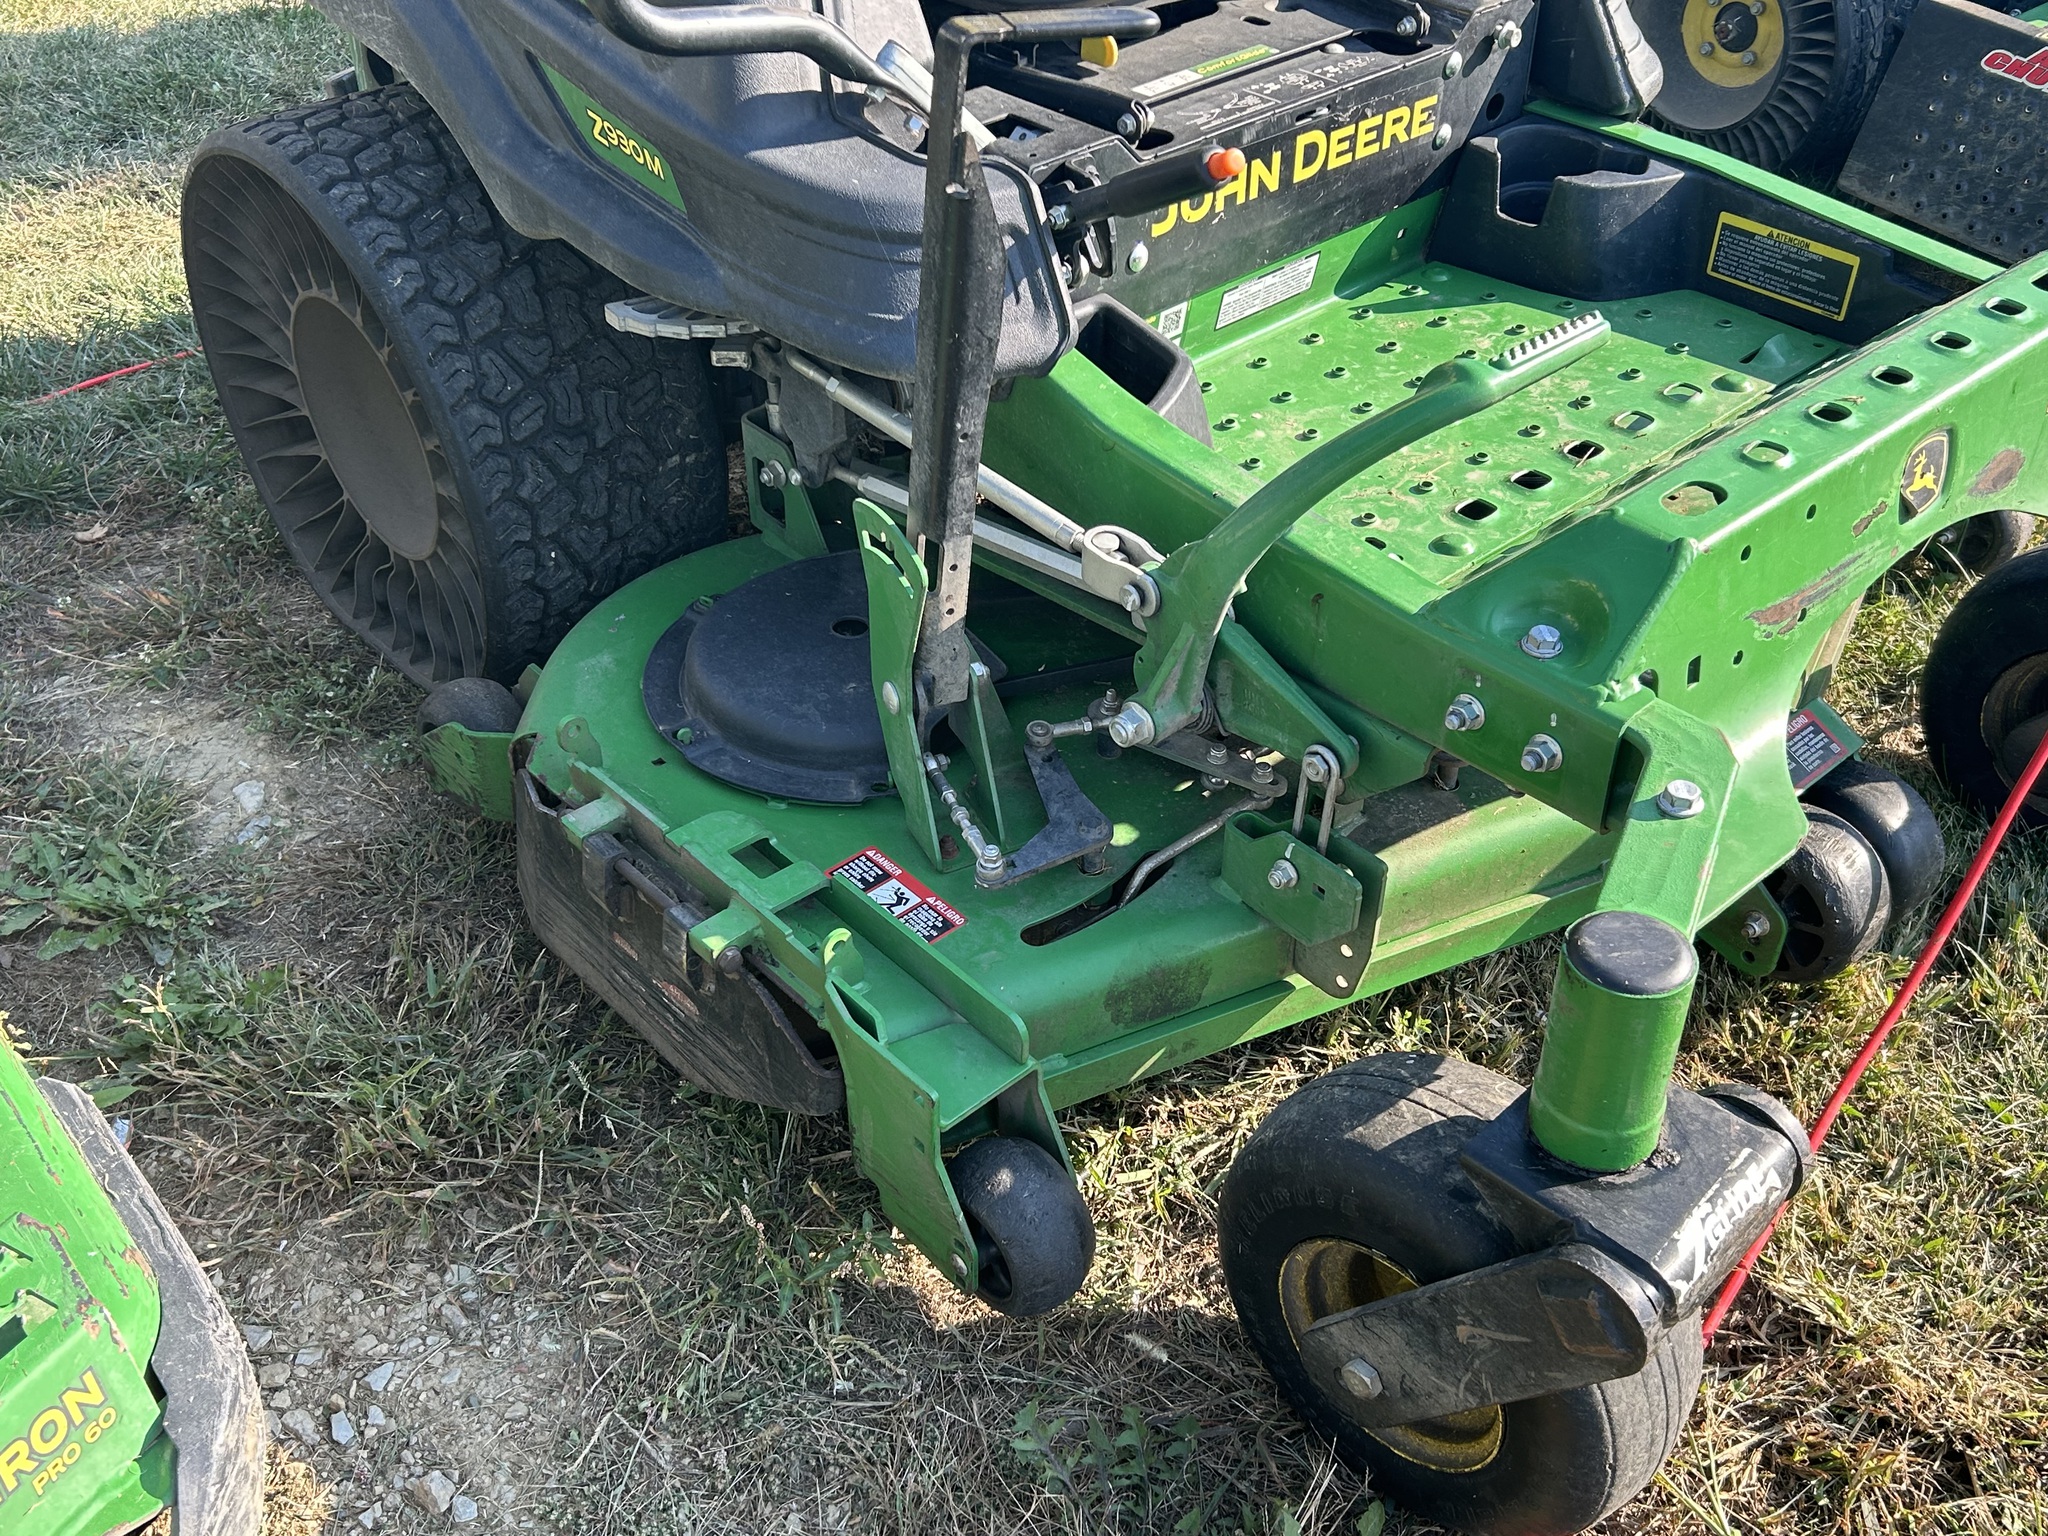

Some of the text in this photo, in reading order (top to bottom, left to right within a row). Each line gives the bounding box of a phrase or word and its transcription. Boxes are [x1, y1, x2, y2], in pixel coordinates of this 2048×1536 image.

[586, 108, 665, 181] Z930M
[1293, 95, 1438, 183] DEERE
[1754, 235, 1774, 245] AYUDAR
[1780, 243, 1798, 252] EVITAR
[1798, 249, 1823, 262] LESIONES
[1775, 233, 1811, 250] ATENCION
[874, 853, 903, 877] DANGER
[933, 900, 966, 926] PELIGRO
[0, 1367, 107, 1502] RON
[31, 1405, 117, 1496] PRO 60
